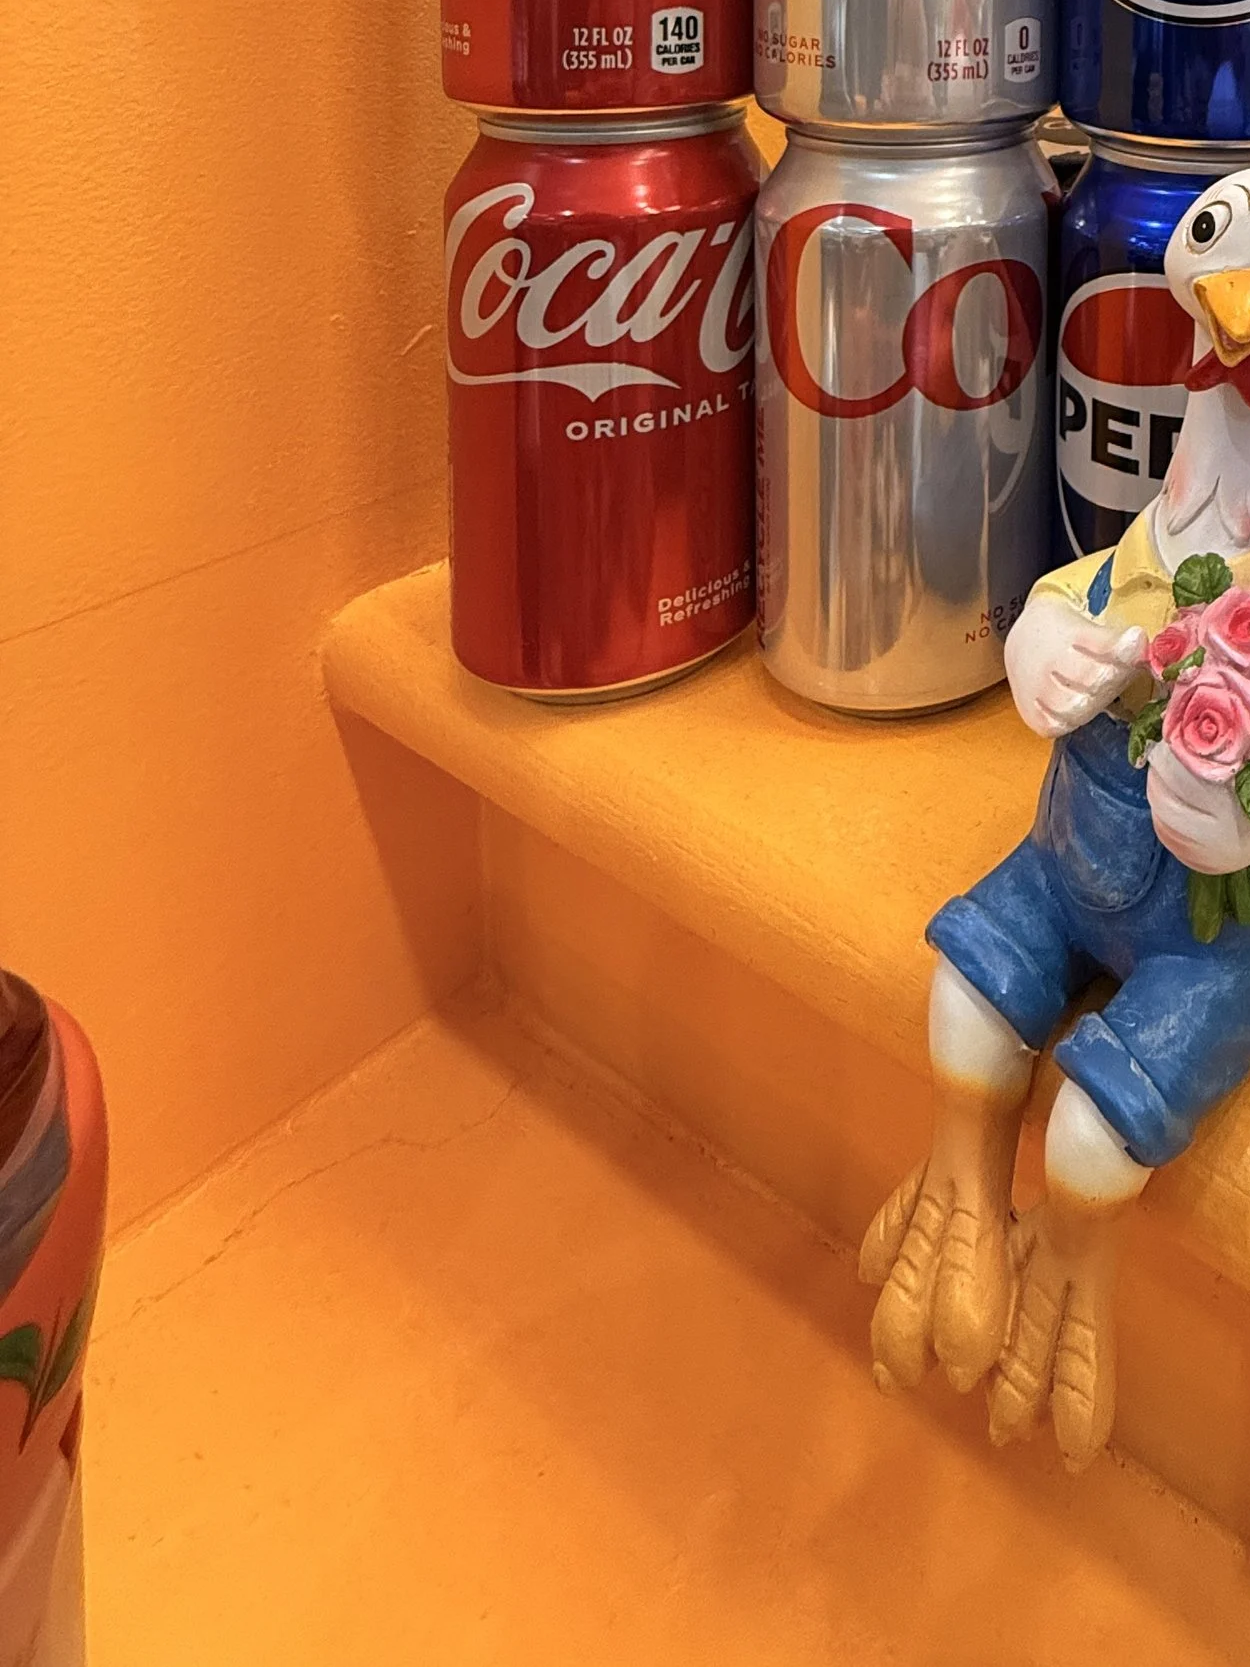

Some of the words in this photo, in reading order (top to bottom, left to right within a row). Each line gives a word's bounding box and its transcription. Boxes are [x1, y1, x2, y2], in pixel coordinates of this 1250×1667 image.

[462, 23, 472, 38] &
[572, 27, 590, 46] 12
[592, 27, 610, 46] FL
[612, 26, 635, 46] OZ
[658, 15, 699, 42] 140
[1019, 25, 1029, 50] 0
[655, 42, 701, 56] CALORIES
[772, 33, 821, 51] SUGAR
[937, 40, 952, 58] 12
[955, 39, 970, 57] FL
[973, 38, 990, 56] OZ
[562, 49, 600, 72] (355
[604, 48, 634, 71] mL)
[661, 57, 678, 67] PER
[680, 55, 696, 65] CAN
[765, 45, 837, 69] CALORIES
[1007, 50, 1040, 65] CALORIES
[927, 61, 959, 82] (355
[962, 58, 990, 80] mL)
[566, 393, 730, 442] ORIGINAL
[658, 569, 740, 613] Delicious
[660, 574, 751, 627] Refreshing
[981, 605, 1004, 624] NO
[965, 626, 990, 644] NO
